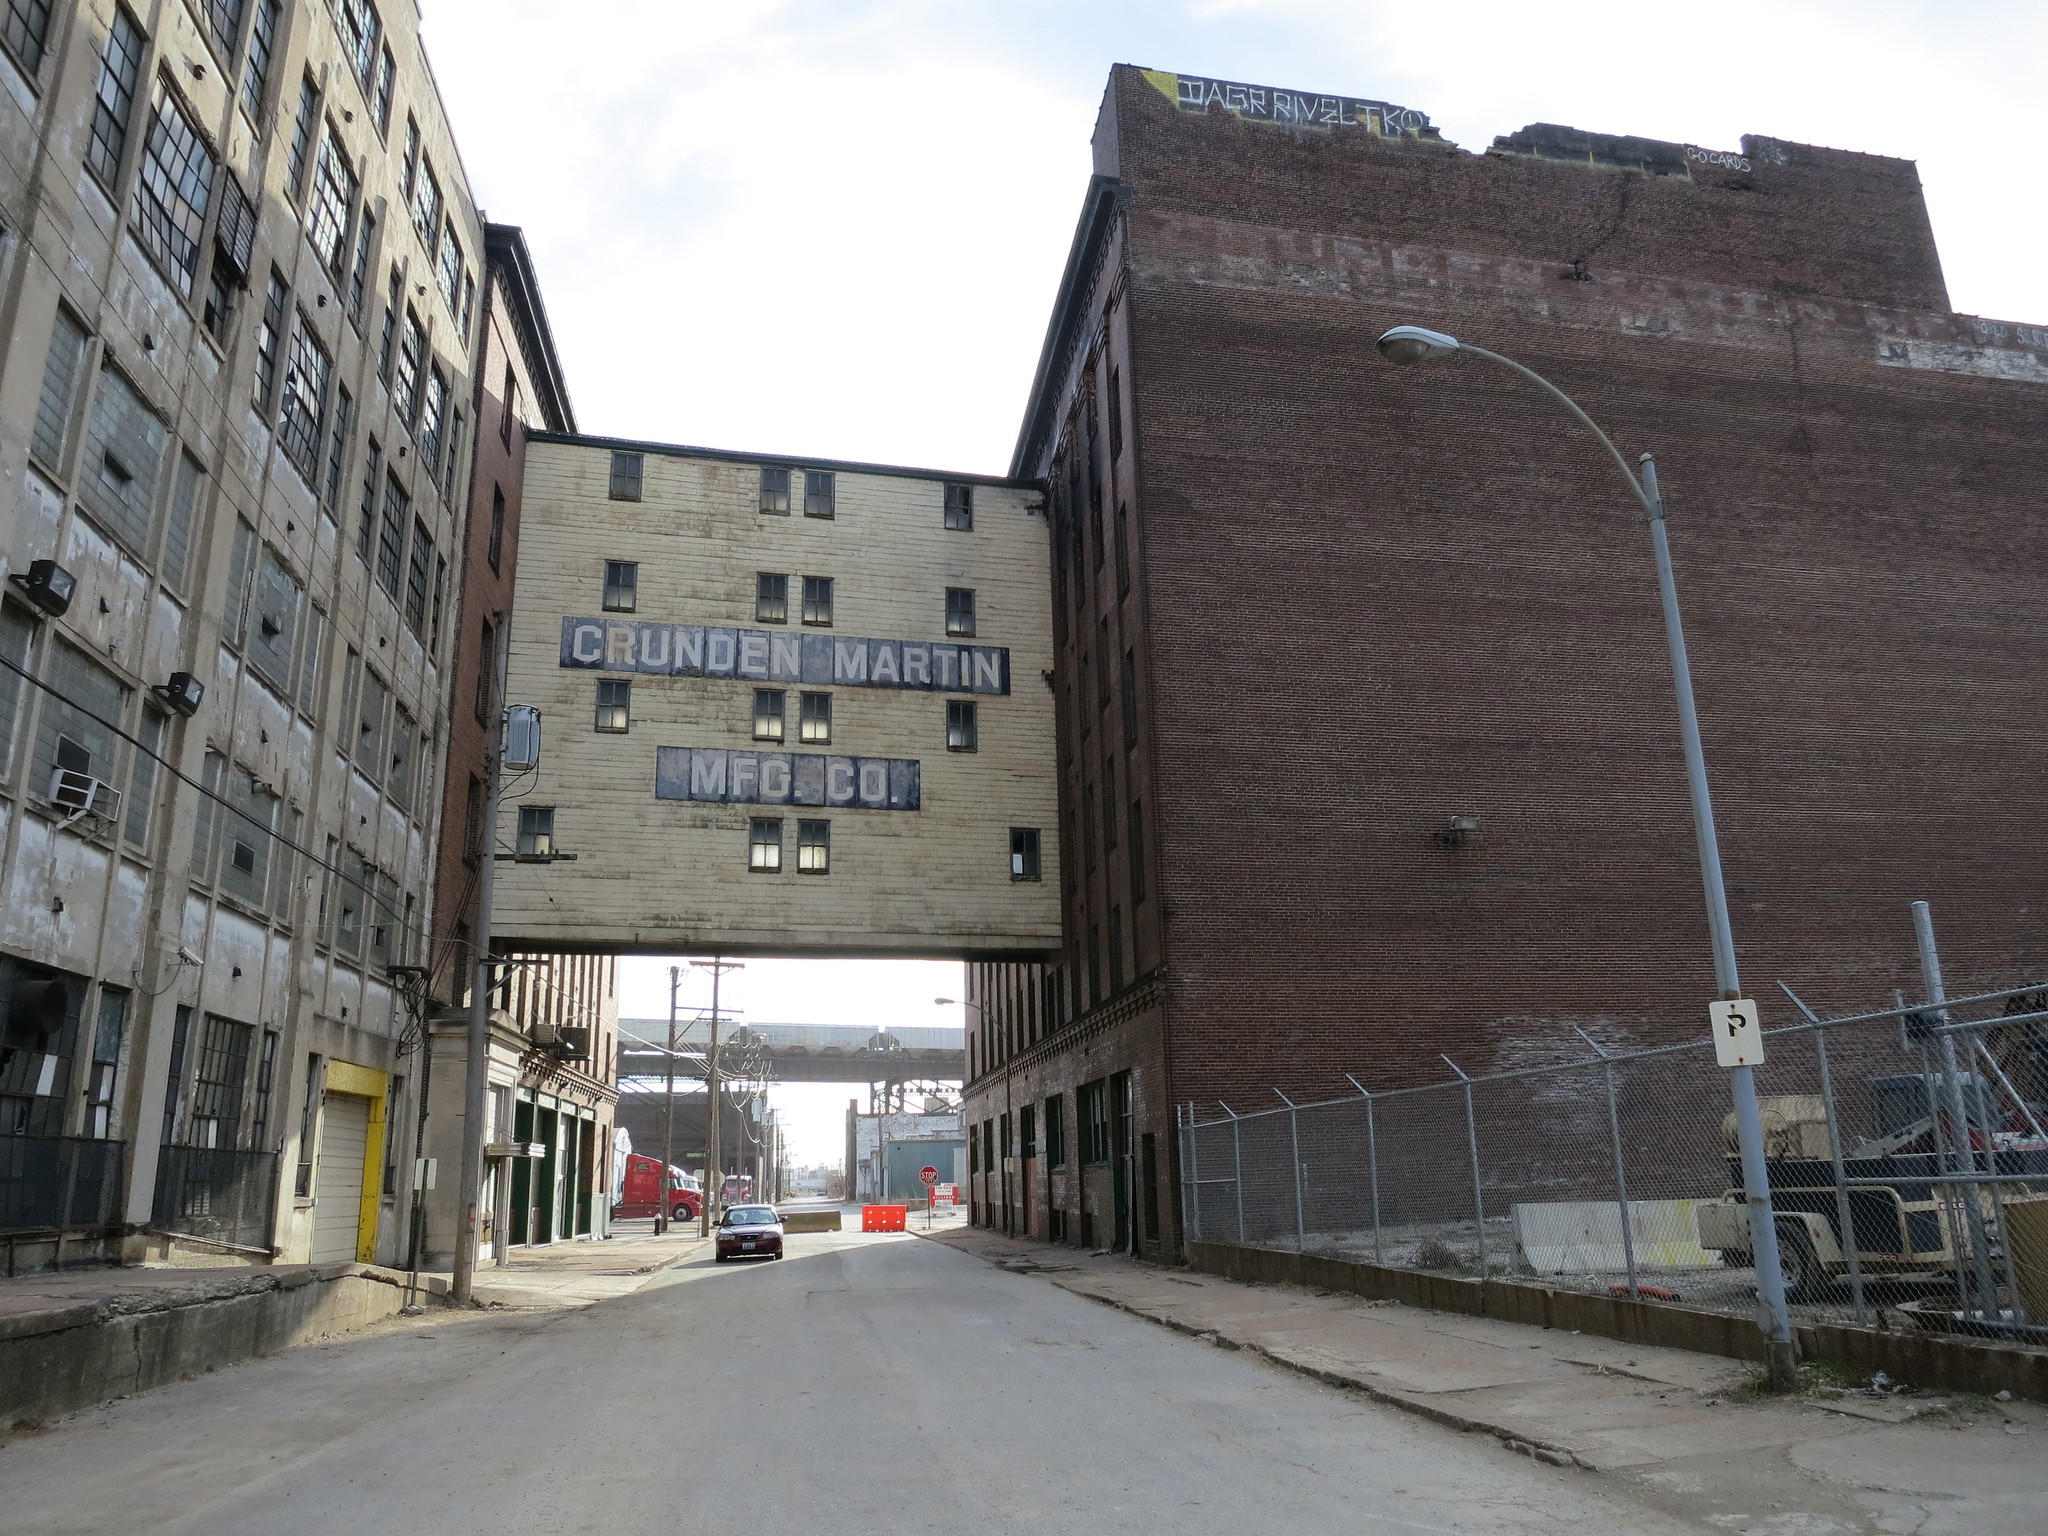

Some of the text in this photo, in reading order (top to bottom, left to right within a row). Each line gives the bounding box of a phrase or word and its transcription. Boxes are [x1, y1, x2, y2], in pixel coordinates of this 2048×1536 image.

[1686, 147, 1707, 163] GO
[1709, 153, 1751, 173] CARDS
[573, 624, 1000, 689] CRUNDEN MARTIN
[690, 755, 898, 803] MFG. CO.
[921, 1171, 937, 1179] STOP
